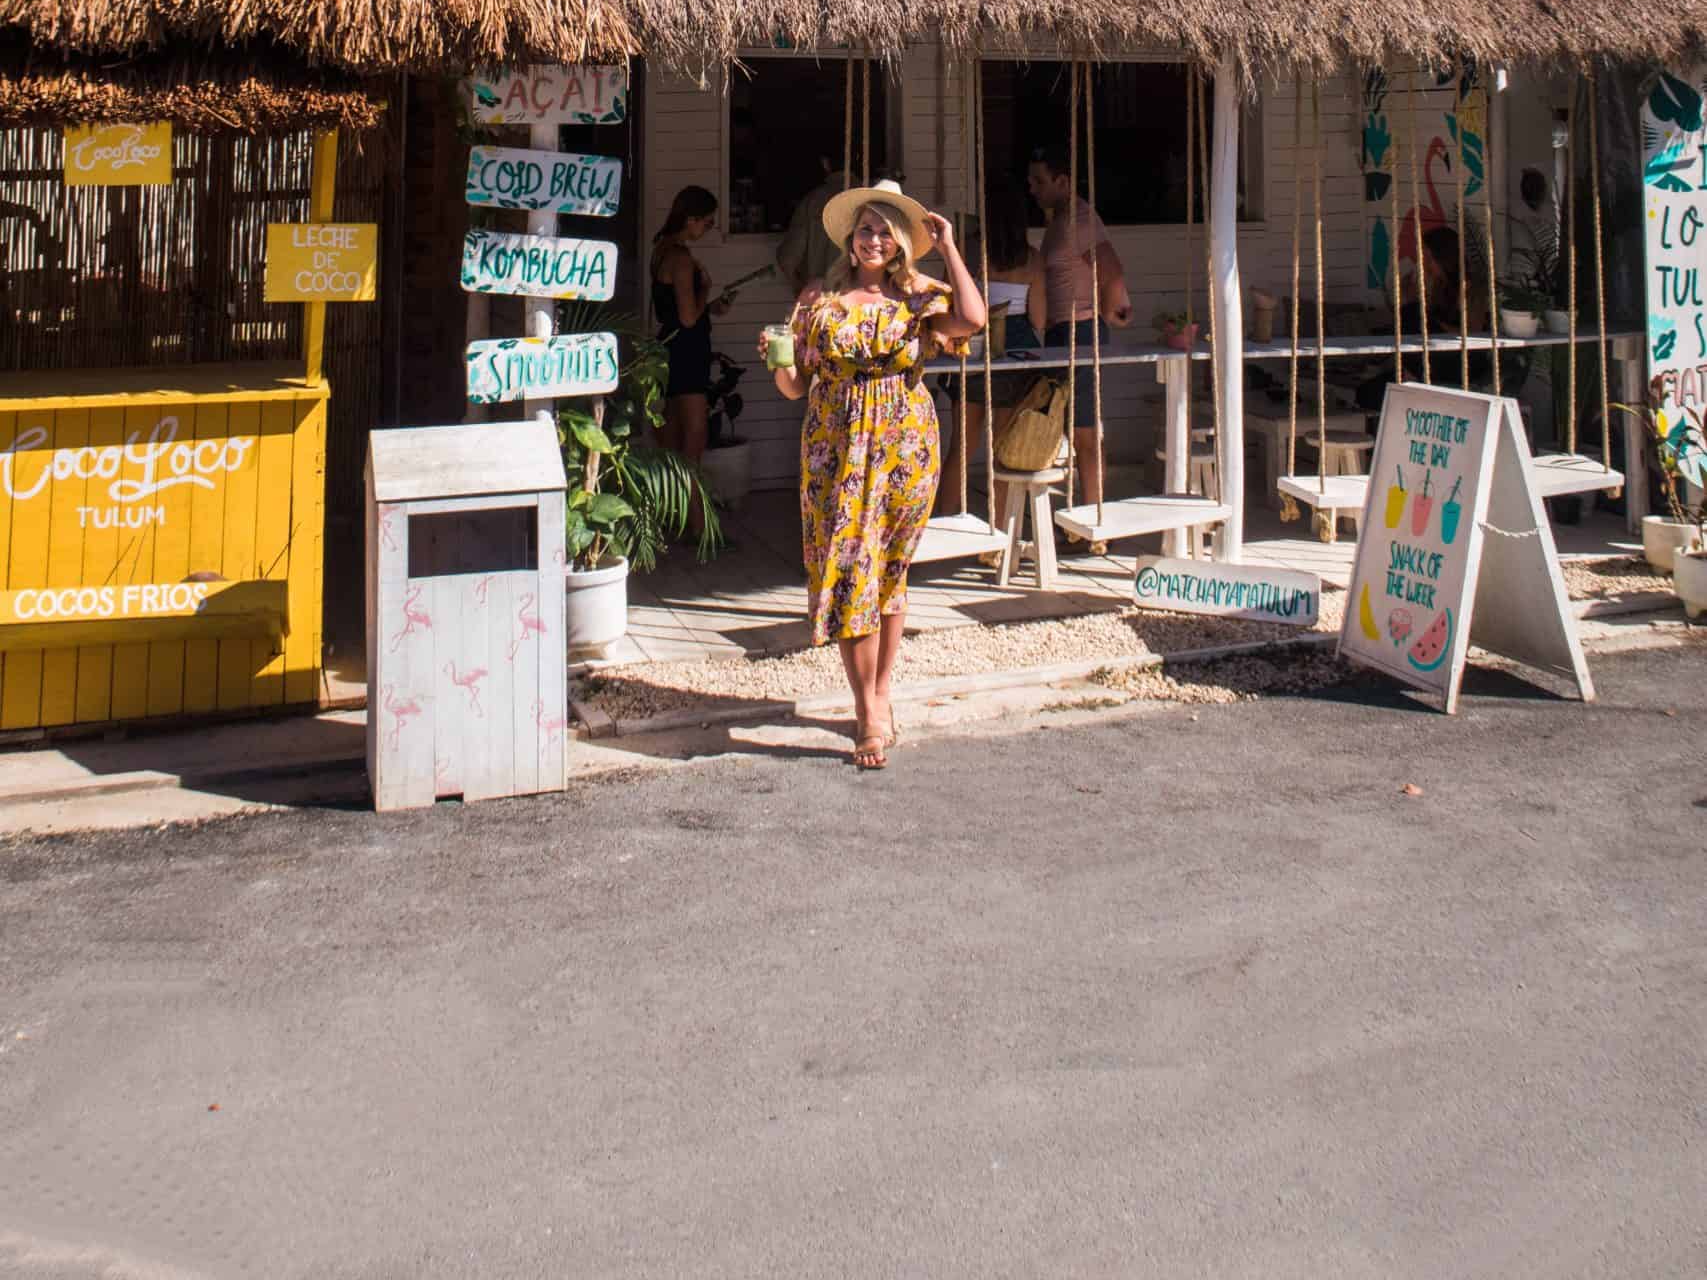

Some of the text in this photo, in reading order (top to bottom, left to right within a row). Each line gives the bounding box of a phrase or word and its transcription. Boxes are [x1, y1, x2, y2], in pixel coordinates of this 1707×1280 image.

[480, 159, 614, 200] COLD BREW
[293, 226, 359, 249] LECHE
[313, 251, 341, 269] DE
[479, 241, 607, 288] KOMBUCHA
[295, 271, 361, 293] COCO
[488, 345, 617, 396] SMOOTHIES
[1405, 408, 1470, 445] SMOOTHIE OF
[1409, 440, 1450, 469] THE DAY
[76, 505, 165, 528] TULUM
[1388, 540, 1444, 580] SNACK OF
[14, 583, 208, 619] COCOS FRIOS
[1136, 566, 1311, 616] @MATCHAMAMATULUM
[1386, 571, 1436, 610] THE WEEK
